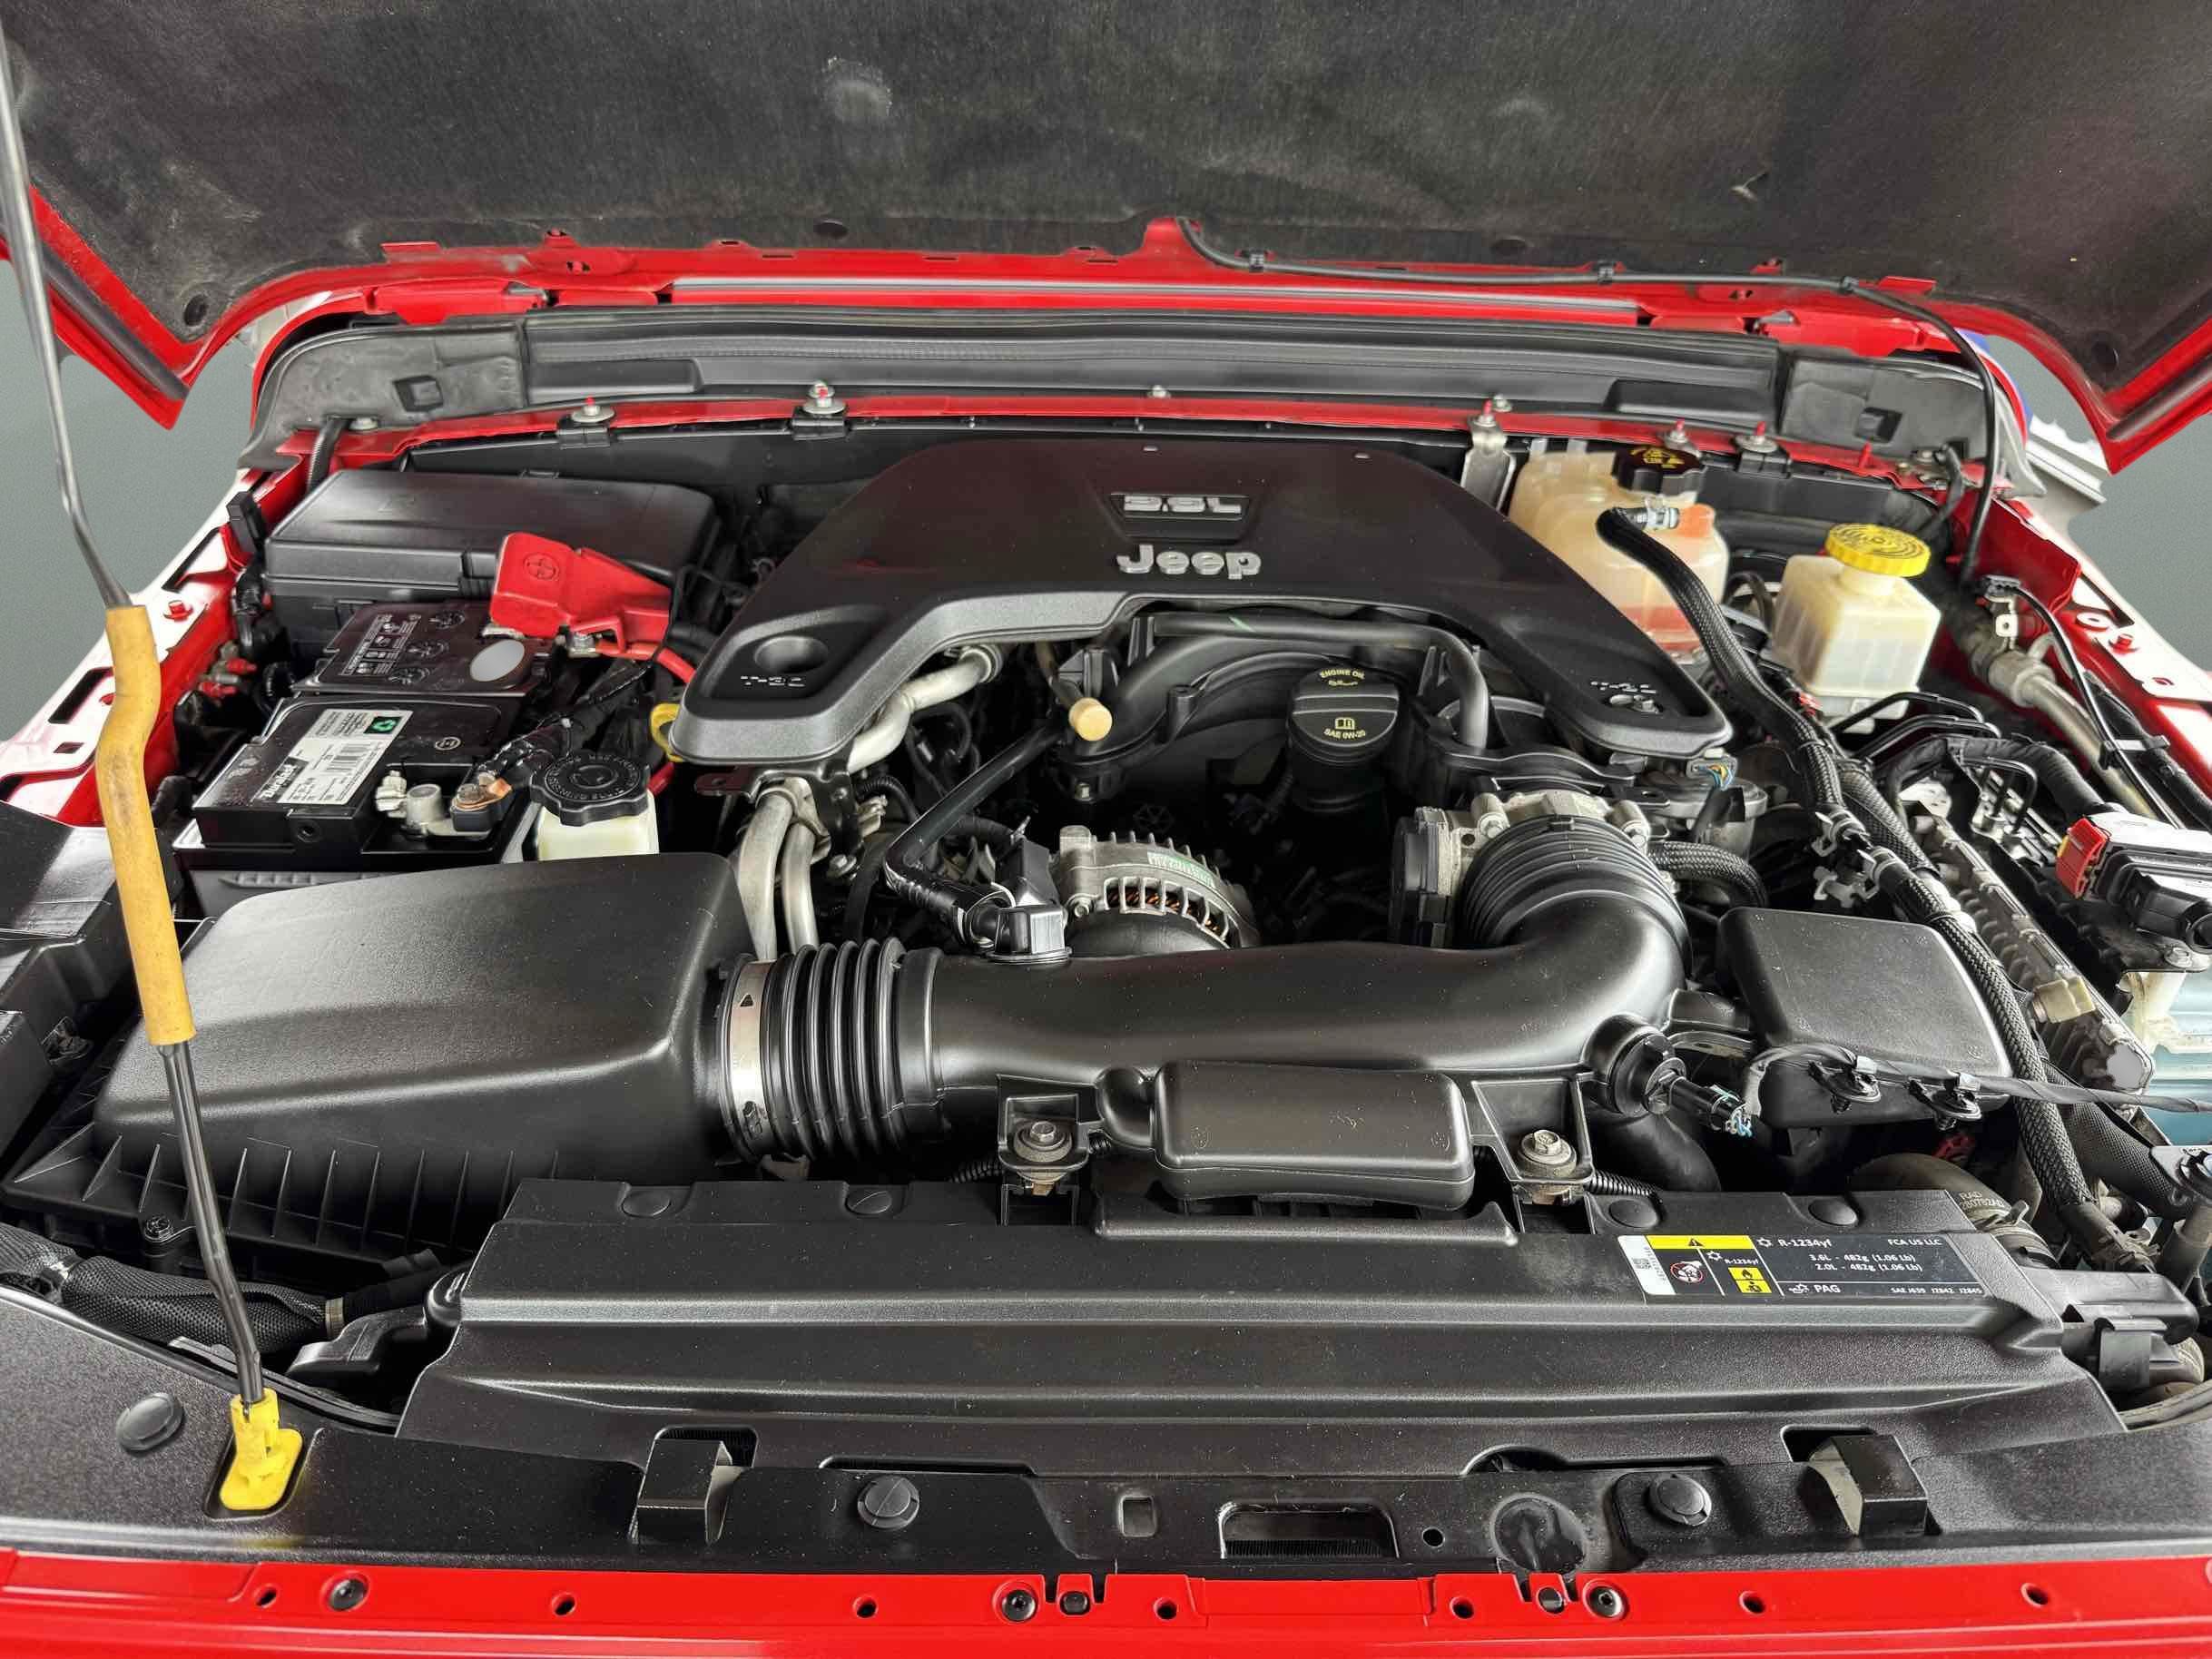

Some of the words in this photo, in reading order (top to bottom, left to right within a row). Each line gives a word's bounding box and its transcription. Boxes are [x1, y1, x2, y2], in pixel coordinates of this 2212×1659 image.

[1116, 544, 1262, 580] Jeep
[1323, 728, 1341, 740] SAE
[1777, 1238, 1833, 1249] R-1234yf
[1887, 1238, 1908, 1246] FCA
[1908, 1238, 1923, 1246] US
[1923, 1238, 1943, 1246] LLC
[1724, 1258, 1759, 1266] R-1234yf
[1808, 1253, 1833, 1262] 3.6L
[1814, 1262, 1838, 1271] 2.0L
[1813, 1284, 1842, 1293] PAG
